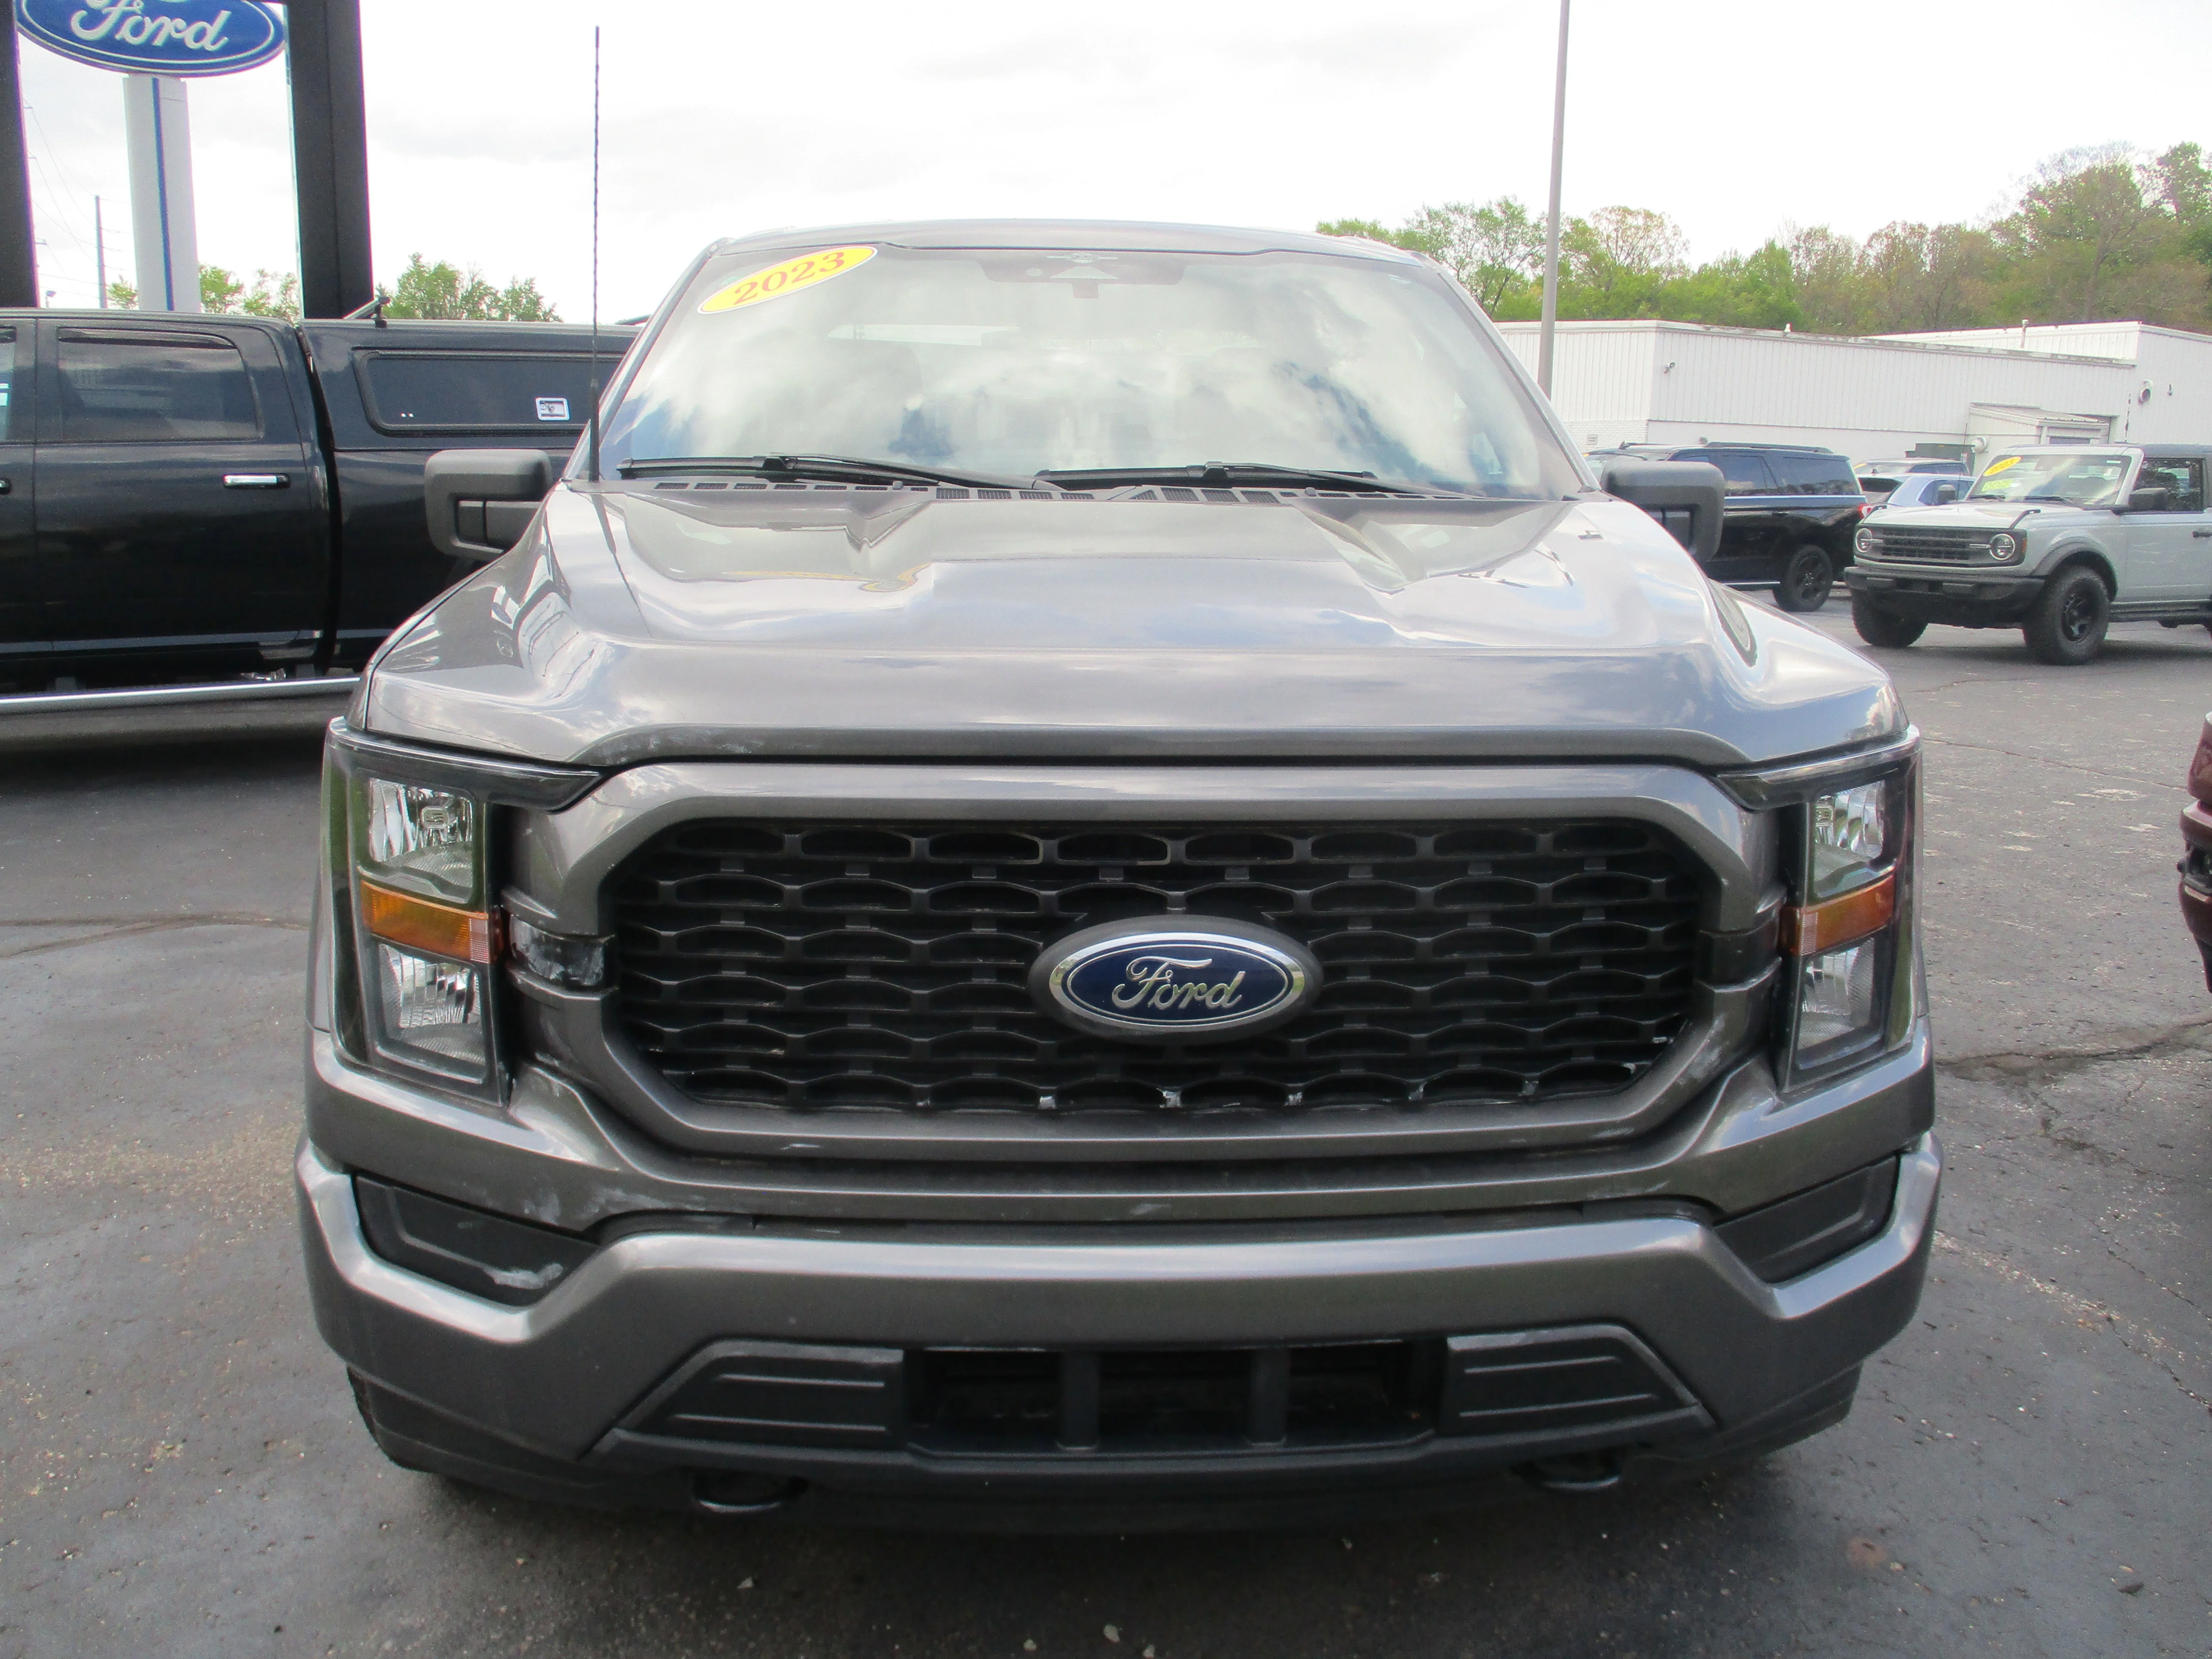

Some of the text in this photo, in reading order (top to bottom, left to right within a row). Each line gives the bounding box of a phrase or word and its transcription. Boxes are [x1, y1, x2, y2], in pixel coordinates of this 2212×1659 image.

[70, 0, 231, 52] Ford
[733, 252, 845, 305] 2023
[1112, 956, 1246, 1009] Ford
